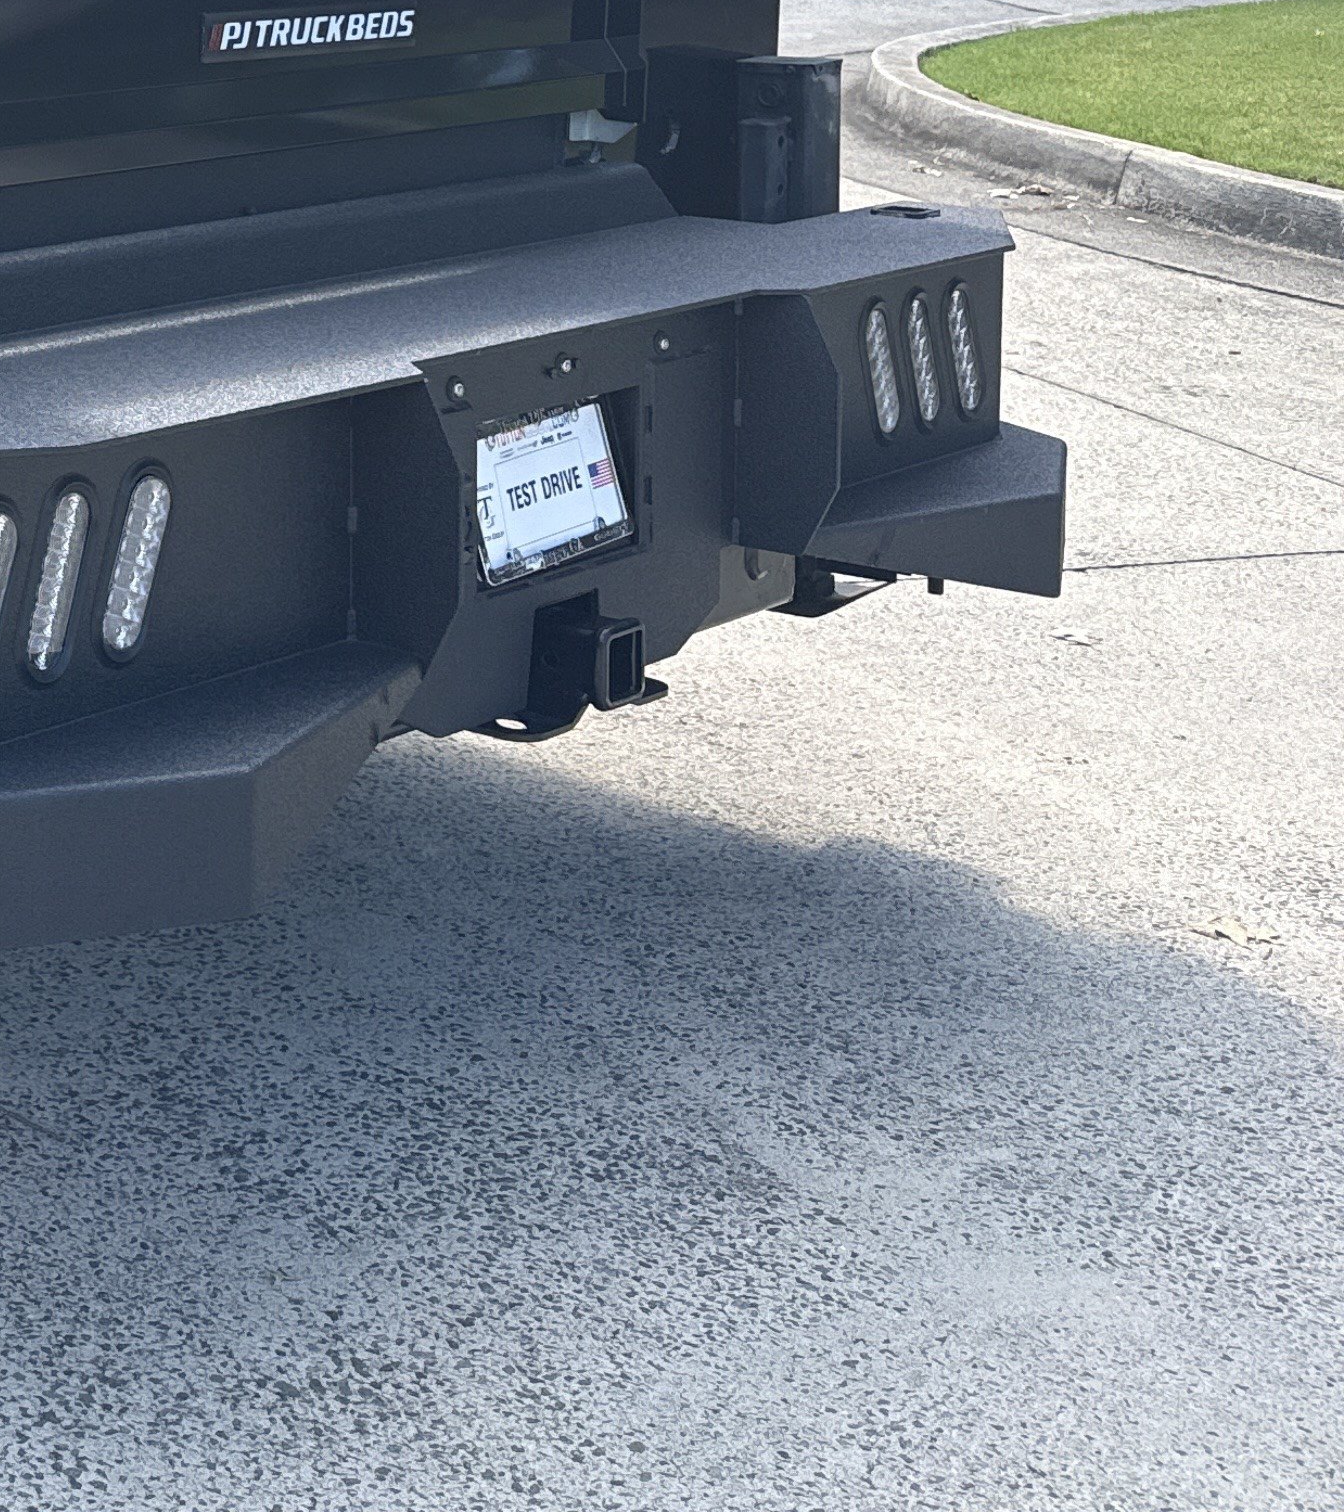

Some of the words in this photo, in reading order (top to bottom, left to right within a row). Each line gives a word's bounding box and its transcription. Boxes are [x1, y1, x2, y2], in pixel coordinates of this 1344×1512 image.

[220, 21, 252, 51] PJ
[255, 15, 344, 48] TRUCK
[344, 10, 416, 41] BEDS
[506, 478, 538, 511] TEST
[541, 465, 583, 499] DRIVE
